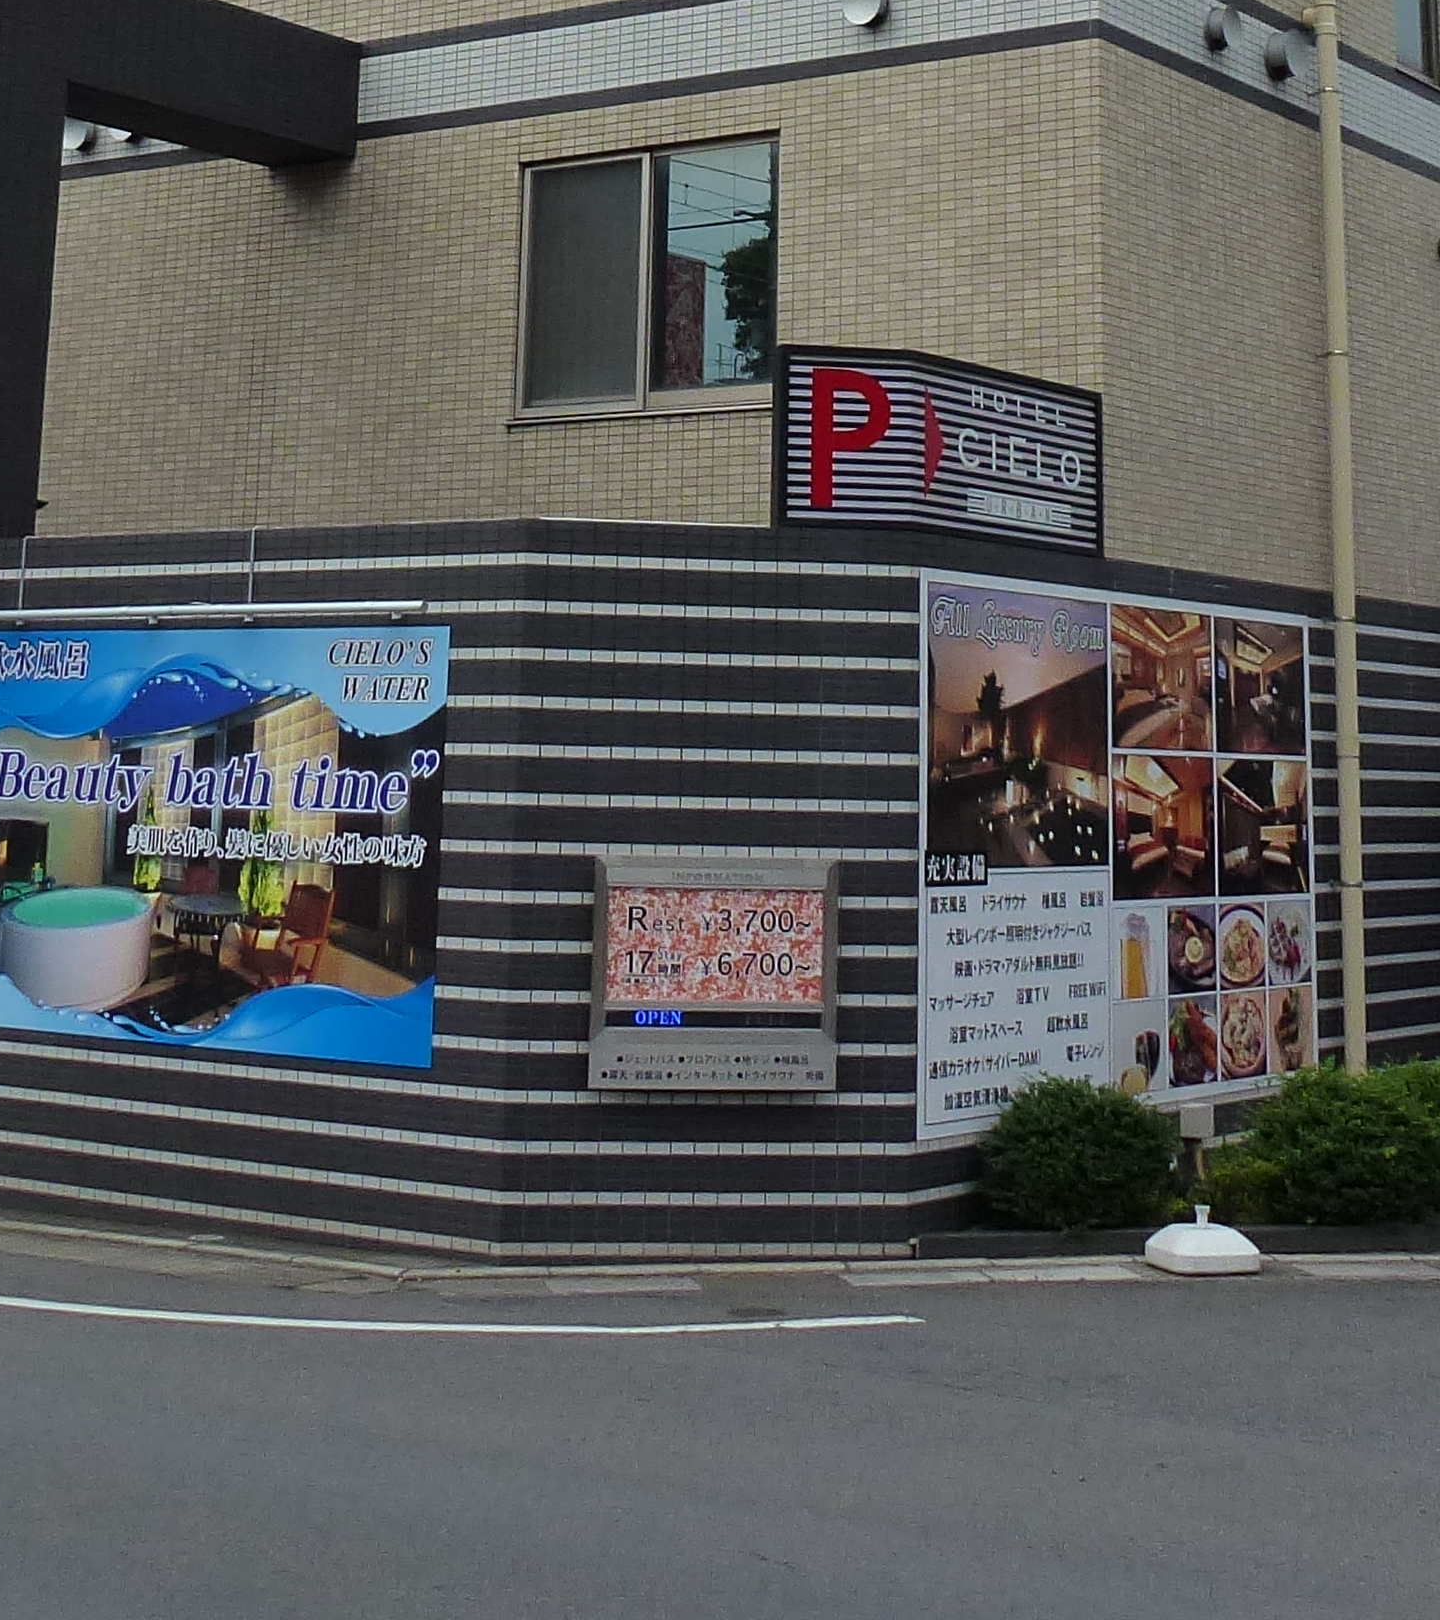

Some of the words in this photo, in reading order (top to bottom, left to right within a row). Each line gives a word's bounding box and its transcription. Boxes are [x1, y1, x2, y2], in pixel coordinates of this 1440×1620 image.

[971, 385, 1066, 428] HOTEL
[810, 367, 891, 508] P
[957, 428, 1082, 489] CIELO
[326, 637, 433, 668] CIELO'S
[340, 674, 431, 704] WATER
[165, 750, 275, 810] bath
[927, 854, 986, 882] 充実設備
[628, 906, 685, 932] Rest
[625, 950, 653, 974] 17
[635, 1010, 682, 1026] OPEN
